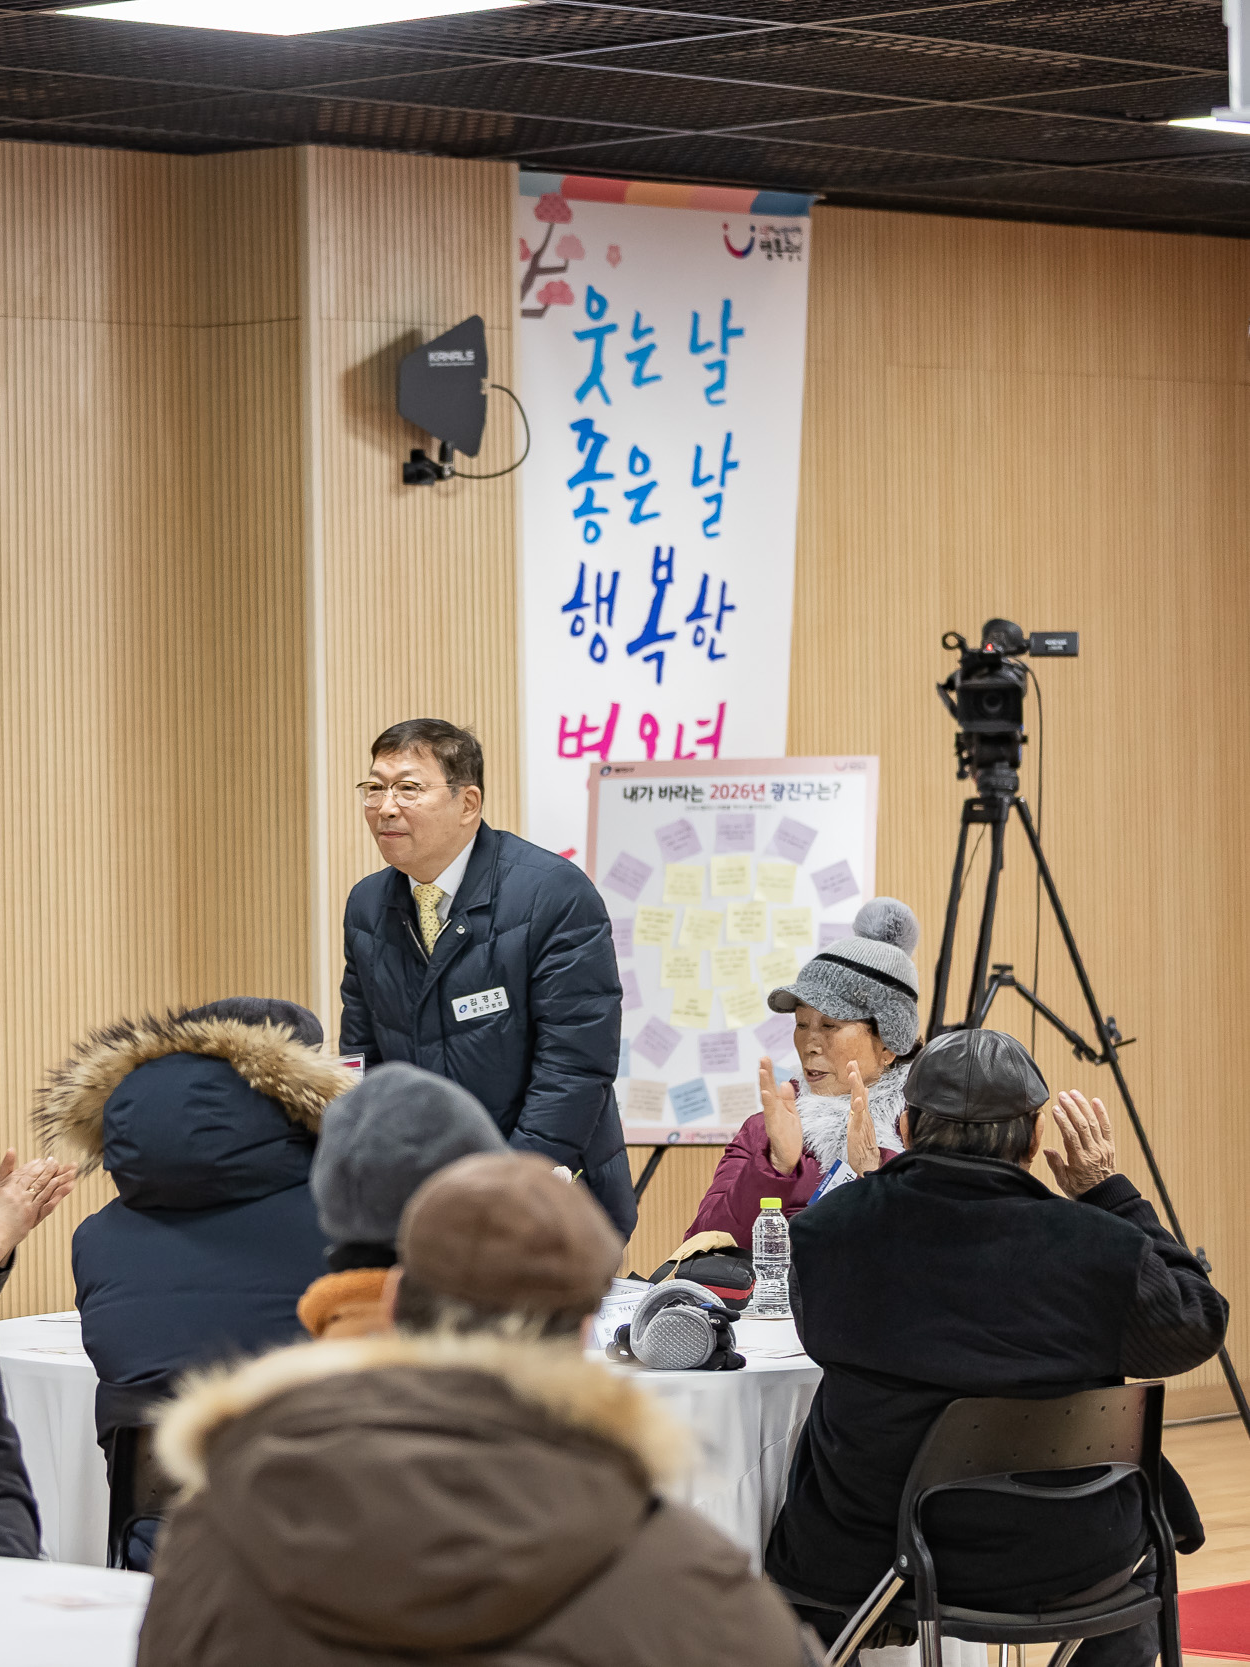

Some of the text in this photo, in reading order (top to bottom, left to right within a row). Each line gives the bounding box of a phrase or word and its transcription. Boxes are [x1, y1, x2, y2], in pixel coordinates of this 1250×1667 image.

[573, 284, 745, 406] 웃는 날
[566, 417, 740, 545] 좋은 날
[561, 545, 737, 686] 행복한
[623, 783, 842, 803] 내가 바라는 2026년 광진구는?
[470, 992, 502, 1006] 김경호
